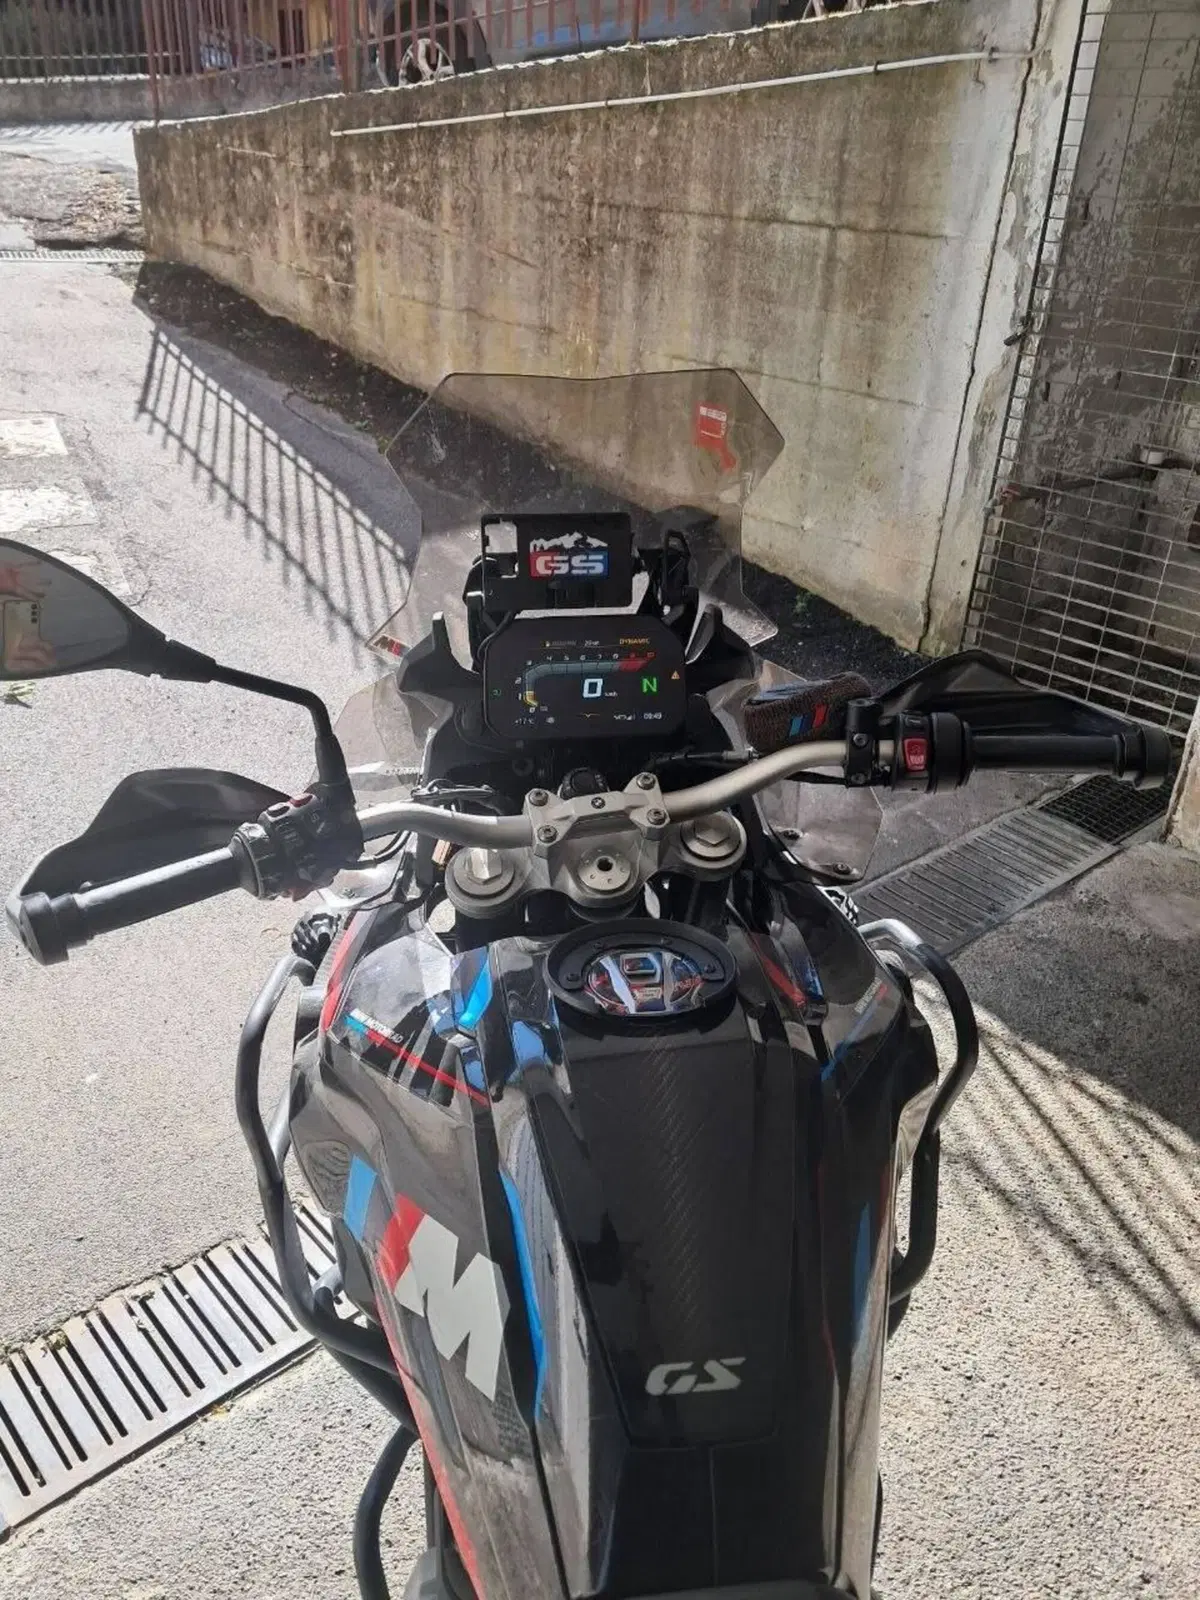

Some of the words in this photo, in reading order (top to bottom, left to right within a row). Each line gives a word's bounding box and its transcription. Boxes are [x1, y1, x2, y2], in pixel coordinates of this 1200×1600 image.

[535, 554, 605, 575] GS
[583, 678, 603, 699] 0
[642, 677, 657, 693] N
[645, 1356, 747, 1397] GS
